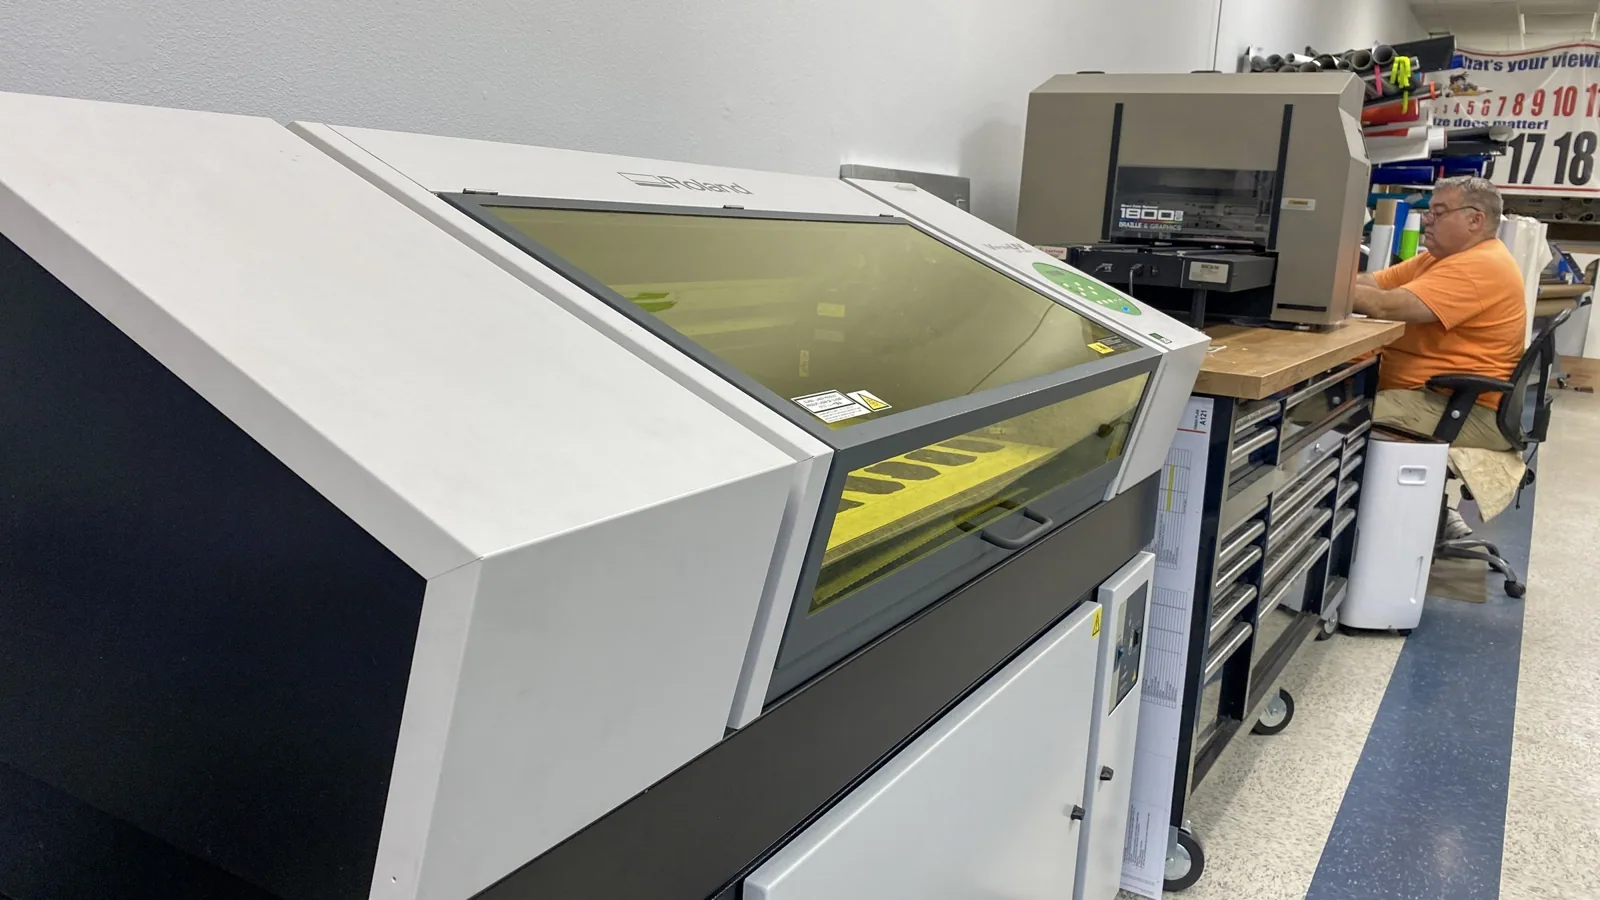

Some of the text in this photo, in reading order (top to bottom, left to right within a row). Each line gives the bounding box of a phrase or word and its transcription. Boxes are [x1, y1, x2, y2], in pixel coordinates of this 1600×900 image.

[1463, 56, 1503, 72] hat's
[1507, 57, 1549, 73] your
[1453, 102, 1460, 115] 4
[1467, 100, 1475, 115] 5
[1481, 98, 1491, 117] 6
[1497, 96, 1507, 117] 7
[1512, 92, 1525, 117] 8
[1531, 88, 1546, 117] 9
[1553, 85, 1578, 117] 10
[1586, 83, 1600, 118] 1
[1432, 116, 1549, 130] ize does matter!
[1508, 133, 1546, 184] 17
[1553, 131, 1597, 186] 18
[656, 175, 754, 195] Roland
[1120, 208, 1174, 220] 1800
[1118, 221, 1142, 229] BRAILLE
[1149, 223, 1182, 231] GRAPHICS
[1199, 410, 1207, 426] A121
